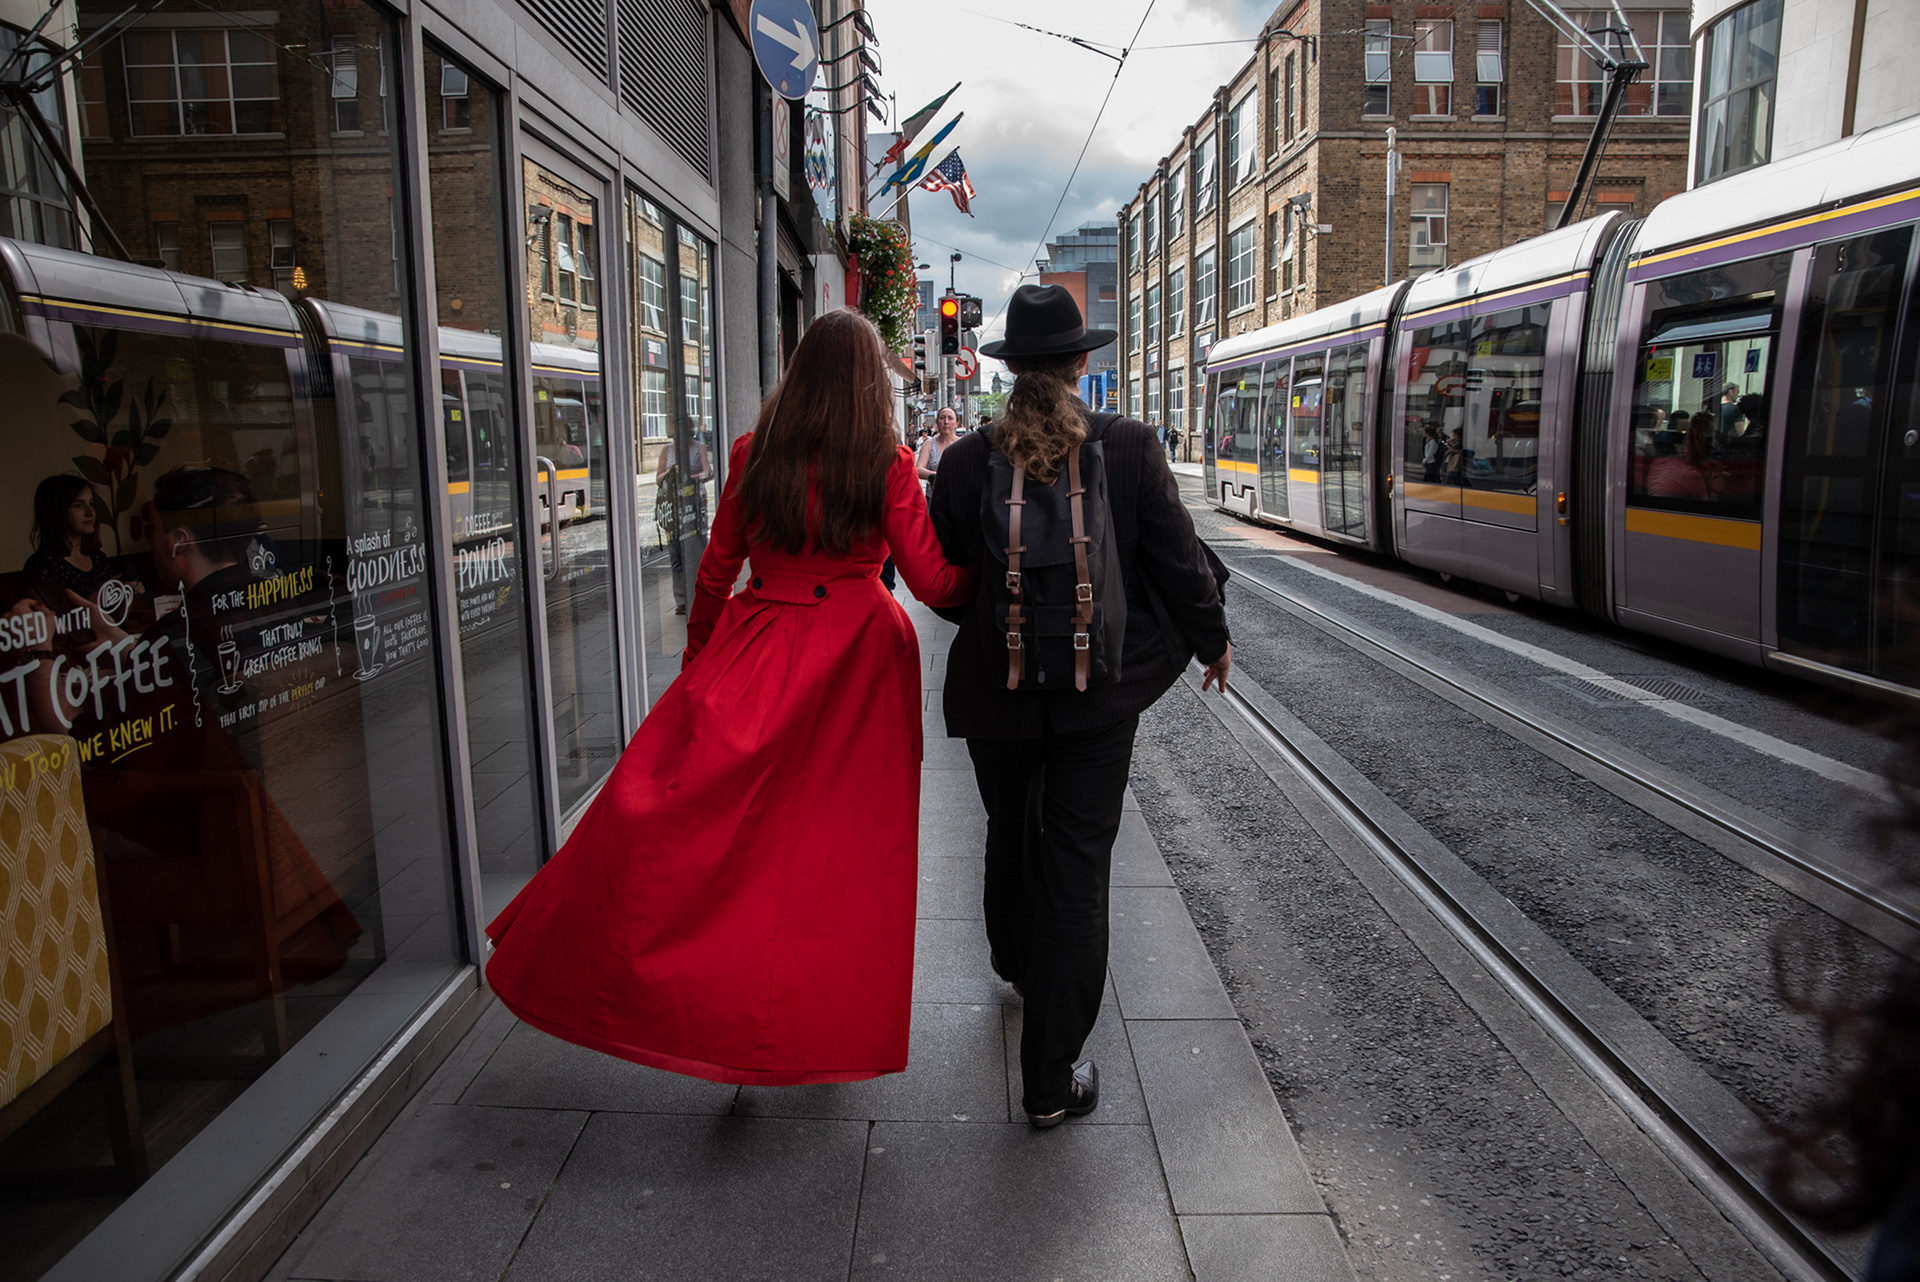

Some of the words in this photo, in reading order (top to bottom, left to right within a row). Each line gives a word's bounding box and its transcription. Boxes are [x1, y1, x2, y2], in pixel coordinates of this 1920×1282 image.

[346, 535, 353, 555] A
[354, 531, 381, 558] splash
[382, 528, 391, 548] of
[459, 537, 509, 593] POWER
[212, 593, 229, 616] FOR
[229, 590, 246, 609] THE
[246, 564, 314, 610] HAPPINESS
[346, 542, 426, 598] GOODNESS
[54, 606, 91, 635] WITH
[259, 625, 282, 648] THAT
[281, 620, 304, 641] TRULY
[383, 624, 393, 637] ALL
[394, 619, 405, 631] OUR
[405, 613, 423, 629] COFFEE
[243, 652, 270, 679] GREAT
[271, 645, 298, 671] COFFEE
[298, 636, 323, 661] BRINGS
[385, 649, 398, 664] NOW
[49, 635, 174, 730] COFFEE
[220, 711, 236, 728] THAT
[238, 704, 256, 721] FIRST
[258, 698, 269, 713] SIP
[270, 695, 278, 709] OF
[278, 690, 290, 705] THE
[291, 683, 314, 701] PERFECT
[315, 676, 326, 690] CUP
[24, 744, 70, 780] TOO?
[78, 733, 105, 763] WE
[109, 716, 153, 752] KNEW
[159, 704, 179, 733] IT.
